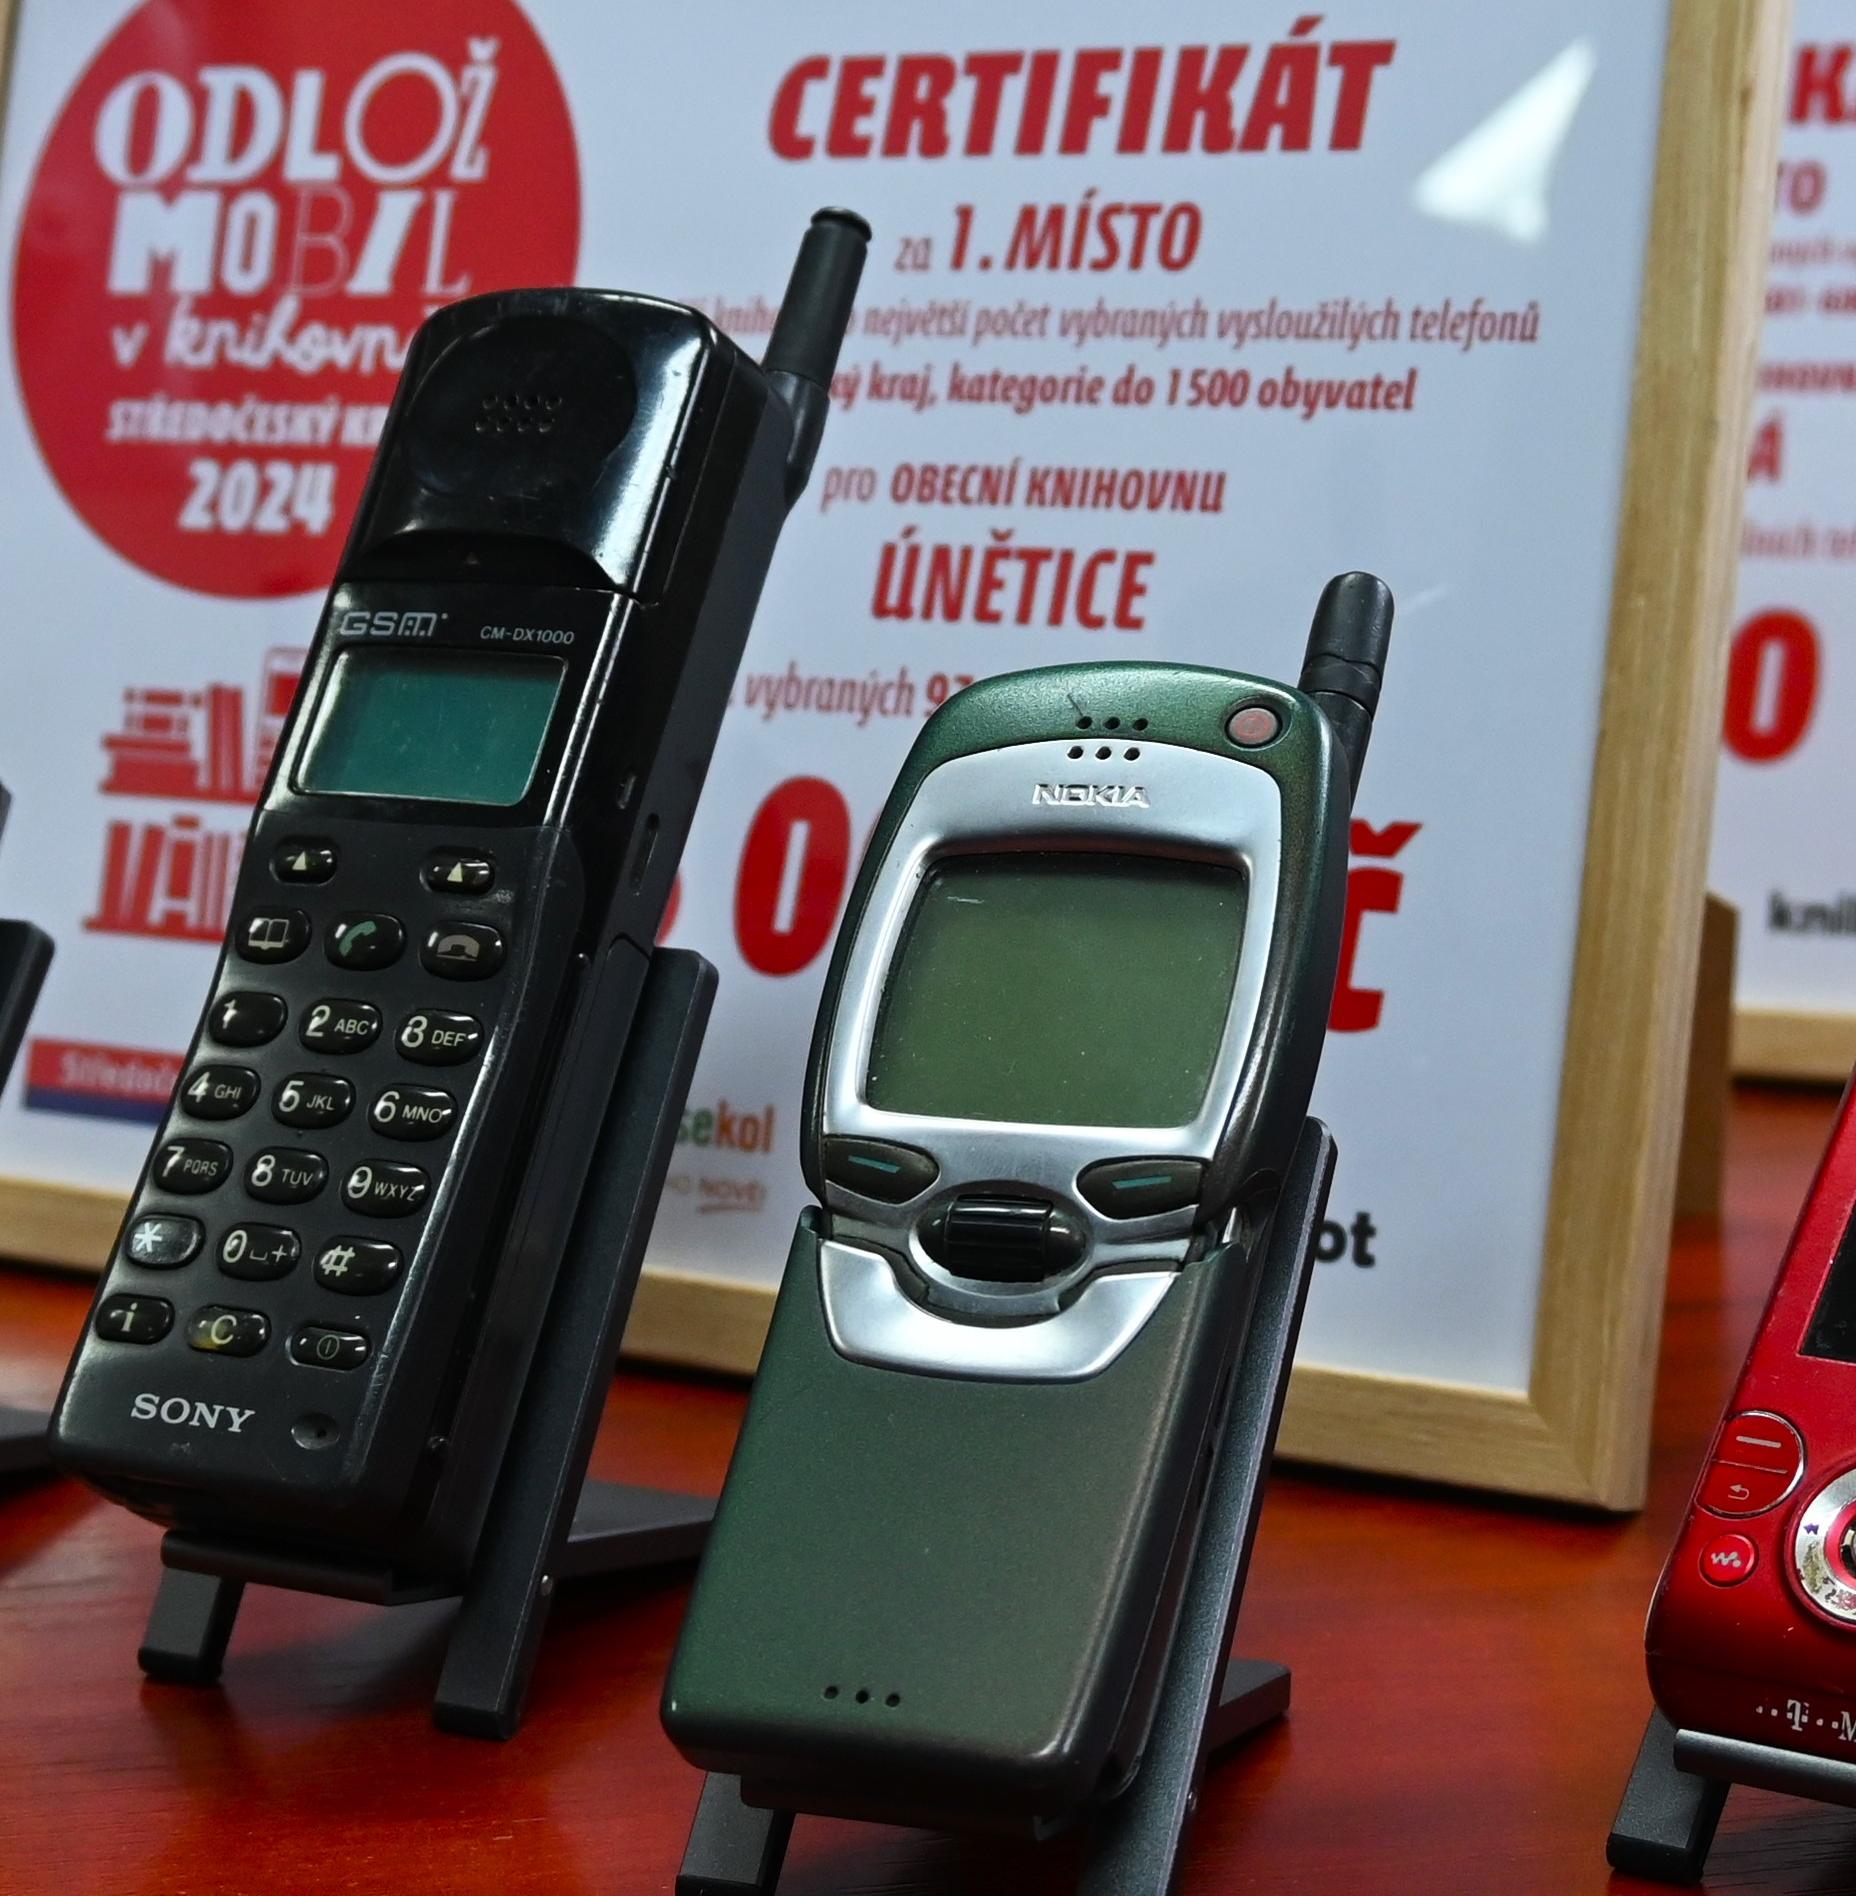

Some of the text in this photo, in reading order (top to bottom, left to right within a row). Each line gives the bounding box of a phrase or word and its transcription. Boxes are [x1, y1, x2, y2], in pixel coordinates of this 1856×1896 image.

[766, 14, 1398, 162] CERTIFIKÁT
[93, 37, 499, 185] ODLOŽ
[106, 186, 471, 297] MOBIL
[894, 187, 1205, 274] za 1. MÍSTO
[111, 291, 434, 376] v knihovn
[865, 299, 971, 347] největší
[974, 297, 1050, 346] počet
[1058, 297, 1209, 349] vybraných
[1216, 297, 1401, 350] vysloužilých
[1409, 297, 1540, 352] telefonů
[867, 359, 937, 412] kraj,
[948, 360, 1106, 415] kategorie
[1112, 363, 1156, 406] do
[1258, 364, 1419, 420] obyvatel
[177, 458, 338, 535] 2024
[820, 457, 1227, 514] pro OBECNÍ KNIHOVNU
[871, 524, 1157, 631] ÚNĚTICE
[340, 610, 575, 645] GSM CM-DX1000
[745, 660, 915, 719] vybraných
[1031, 783, 1152, 809] NOKIA
[305, 1005, 370, 1037] 2 ABC
[401, 1015, 468, 1048] 3 DEF
[188, 1071, 243, 1103] 4 GHI
[278, 1080, 336, 1112] 5 JKL
[374, 1090, 443, 1124] 6 MNO
[162, 1145, 185, 1178] 7
[251, 1154, 314, 1187] 8 TUV
[347, 1165, 424, 1202] 9 WXYZ
[222, 1229, 248, 1264] 0
[210, 1314, 237, 1345] C
[130, 1393, 256, 1433] SONY
